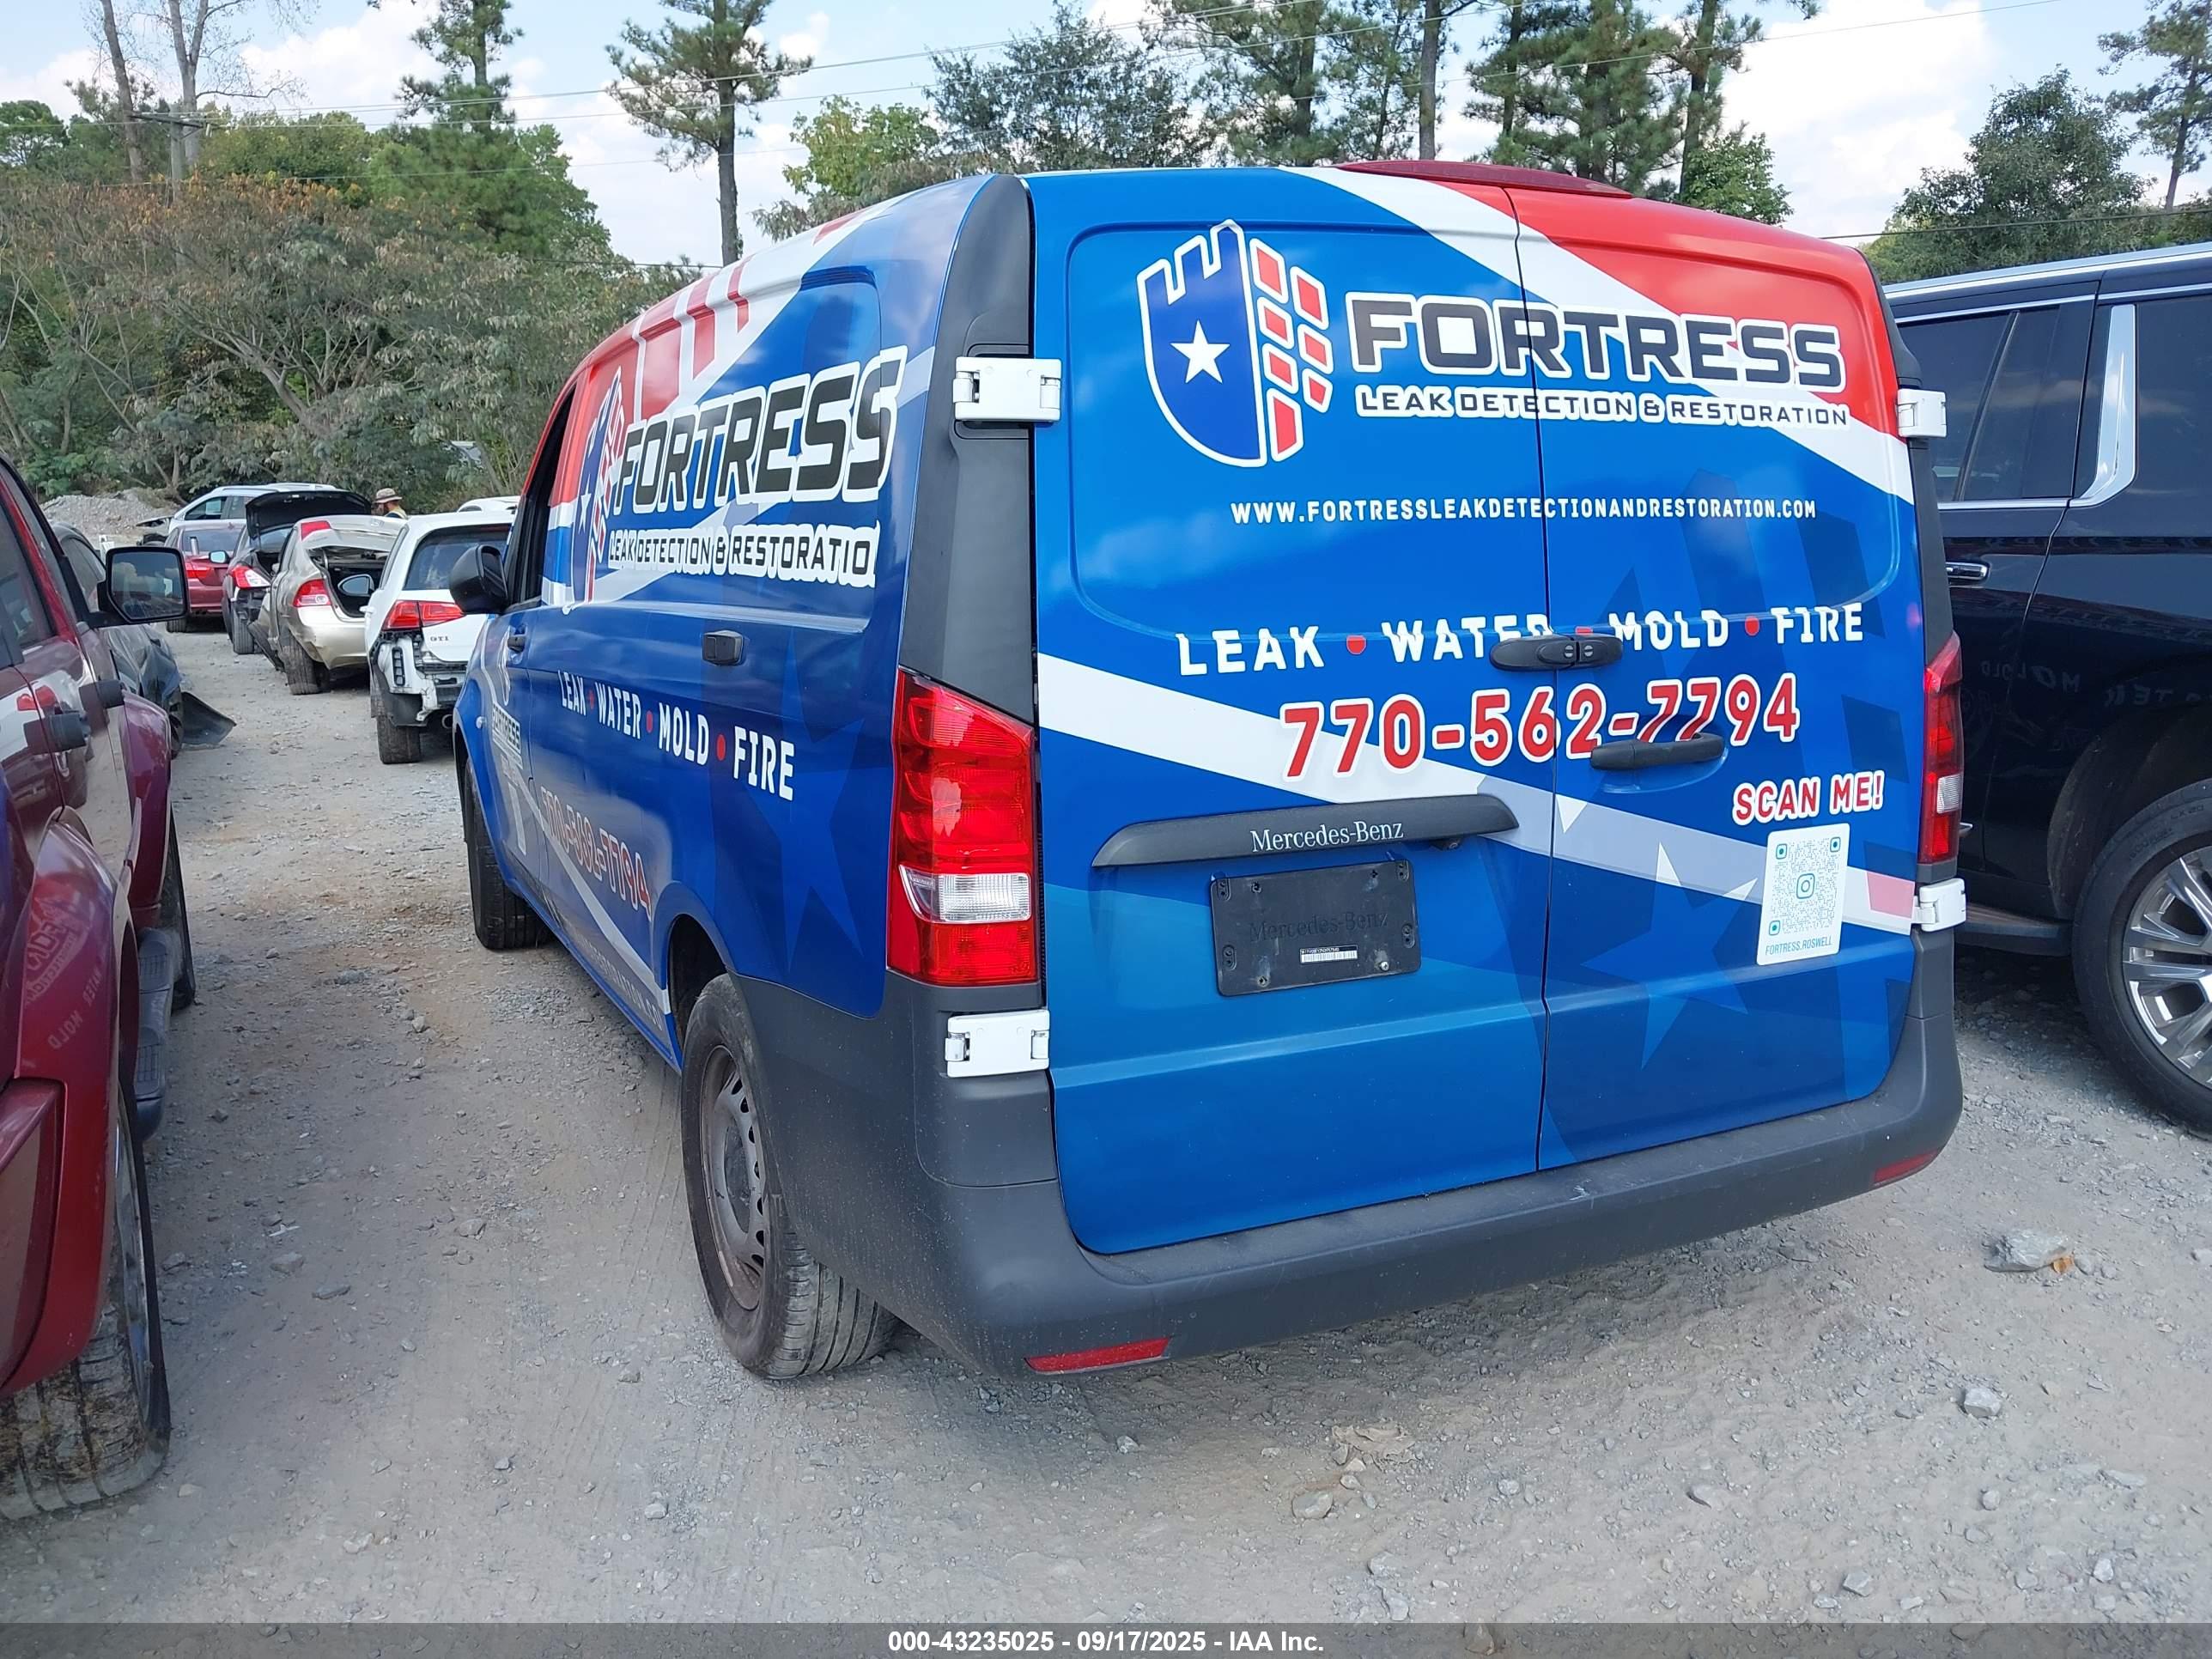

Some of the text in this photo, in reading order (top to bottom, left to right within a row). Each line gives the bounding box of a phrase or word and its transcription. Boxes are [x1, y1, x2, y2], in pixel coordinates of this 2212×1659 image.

[1347, 293, 1845, 392] FORTRESS
[1359, 389, 1849, 428] LEAK DETECTION & RESTORATION
[614, 350, 905, 513] FORTRESS
[1230, 497, 1817, 524] WWW.FORTRESSLEAKDETECTIONANDRESTORATION.COM
[609, 528, 635, 565] LEAK
[635, 532, 712, 568] DETECTION
[715, 534, 728, 568] &
[1176, 626, 1325, 676] LEAK
[1608, 610, 1729, 651] MOLD
[1770, 603, 1863, 644] FIRE
[557, 669, 795, 801] LEAK WATER MOLD FIRE
[1280, 673, 1800, 781] 770-562-7794
[1734, 772, 1884, 823] SCAN ME!
[1250, 820, 1405, 853] Mercedes-Benz
[1249, 911, 1389, 943] Mercedes-Benz
[1765, 936, 1832, 956] FORTRESS.ROSWELL
